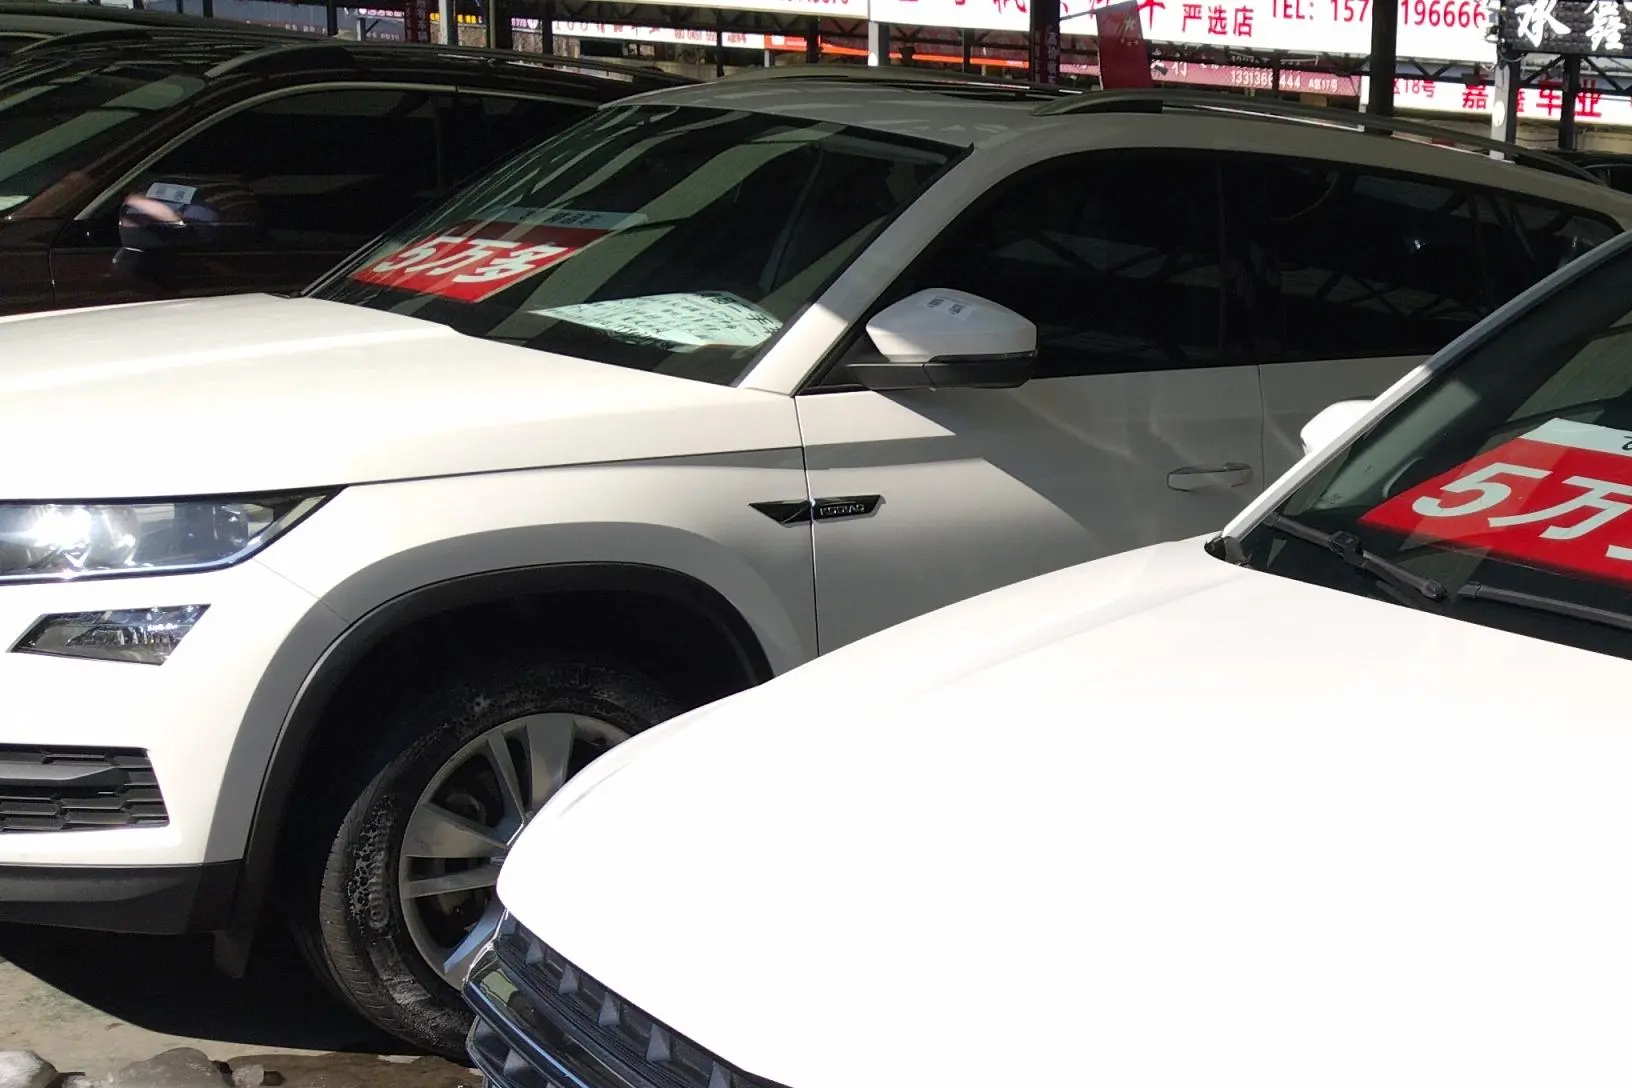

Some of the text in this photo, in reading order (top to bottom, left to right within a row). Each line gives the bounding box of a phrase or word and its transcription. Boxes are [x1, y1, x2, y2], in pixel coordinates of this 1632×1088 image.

[1182, 3, 1254, 37] 严选店
[1331, 0, 1486, 29] 157196666
[373, 236, 579, 284] 5万多
